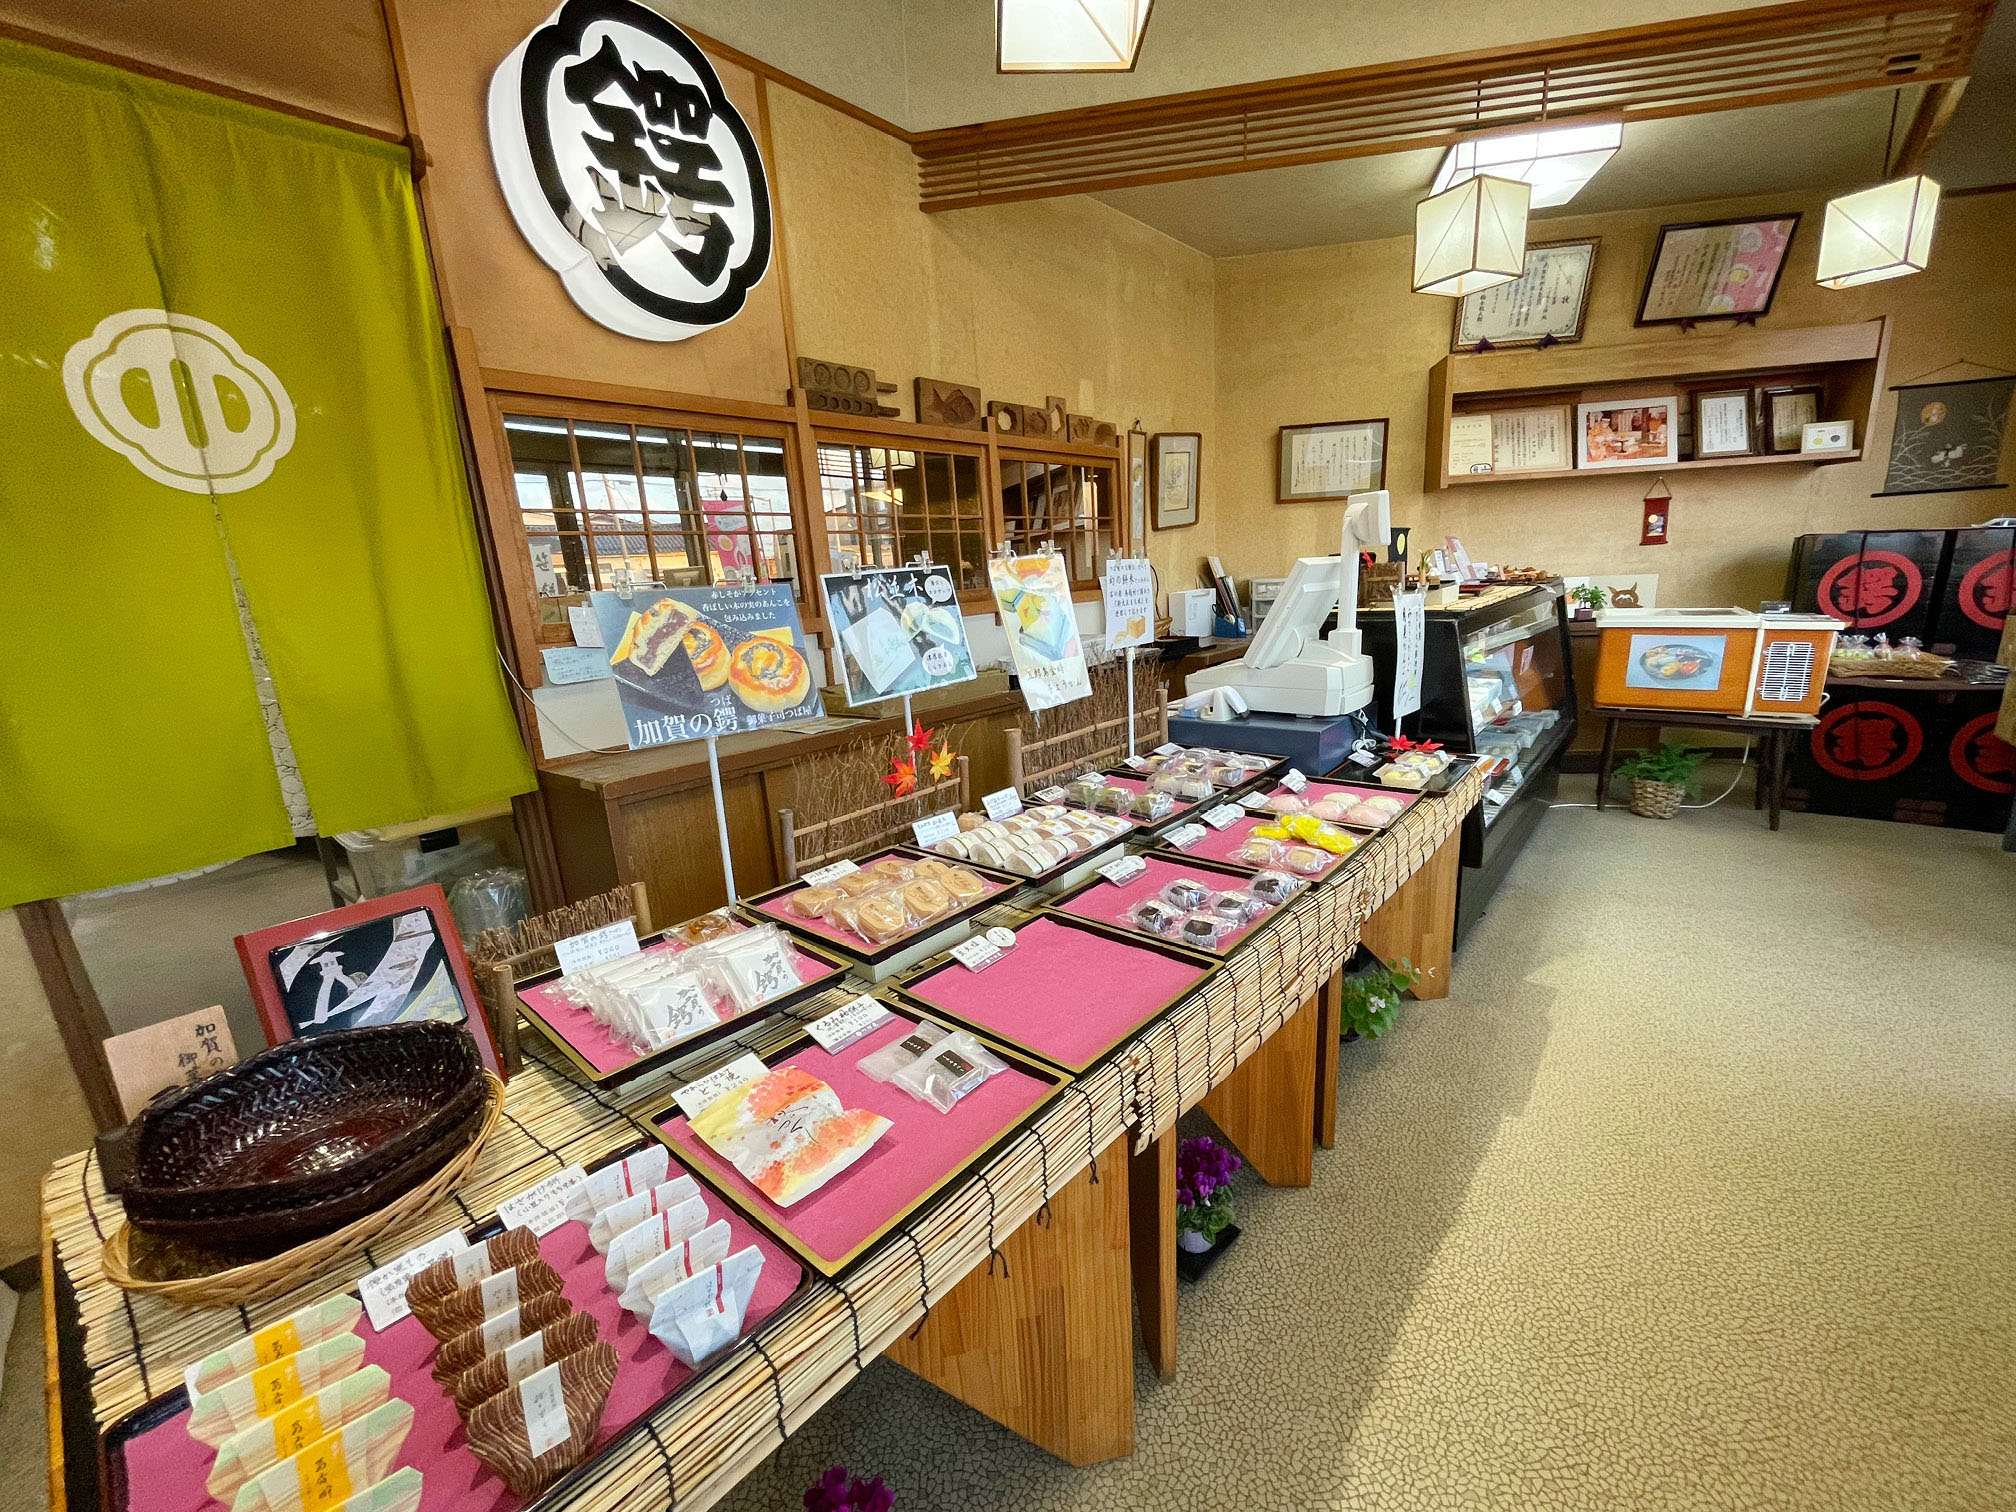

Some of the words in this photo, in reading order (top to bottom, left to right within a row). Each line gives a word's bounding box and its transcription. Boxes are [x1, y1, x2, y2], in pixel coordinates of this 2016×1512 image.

[861, 572, 924, 601] 松並木
[702, 598, 791, 613] 香ばしい木の実のあんこを
[723, 611, 777, 623] 包み込みました
[710, 695, 732, 706] つば
[633, 705, 739, 746] 加賀の鍔
